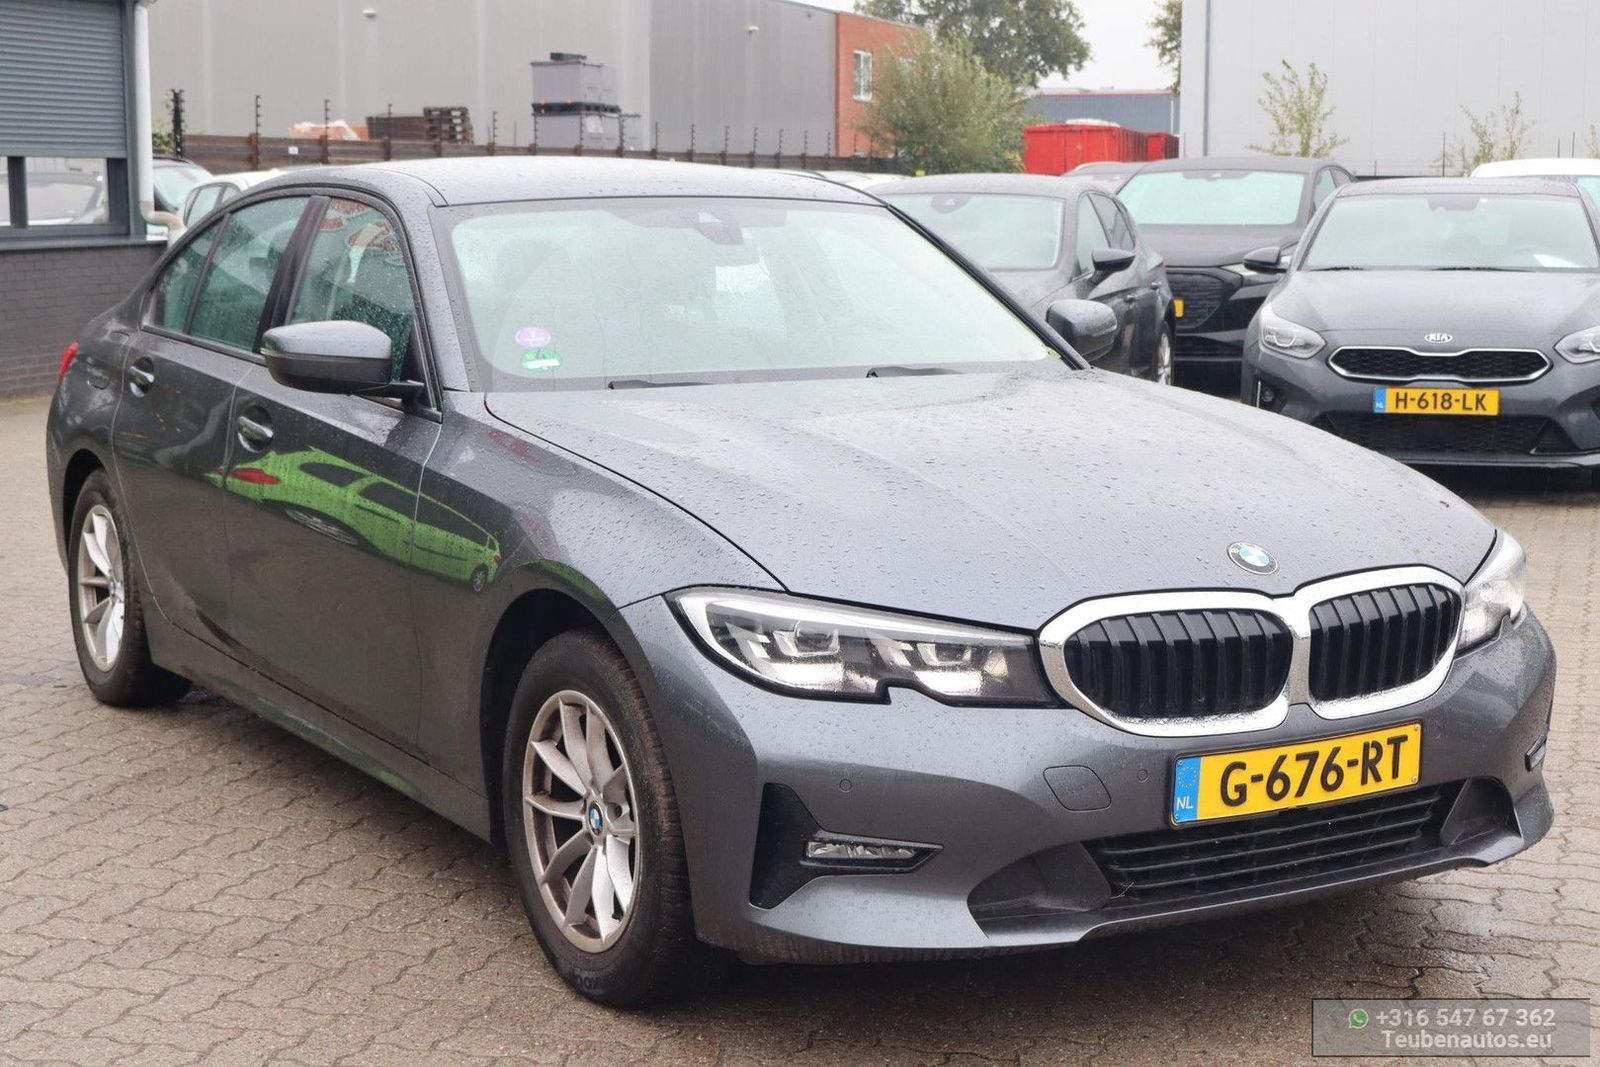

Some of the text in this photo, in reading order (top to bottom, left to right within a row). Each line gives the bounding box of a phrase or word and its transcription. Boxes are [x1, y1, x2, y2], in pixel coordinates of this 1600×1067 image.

[1427, 332, 1450, 342] KIA
[1395, 392, 1487, 411] H-618-LK
[1176, 734, 1408, 810] NL G-676-RT
